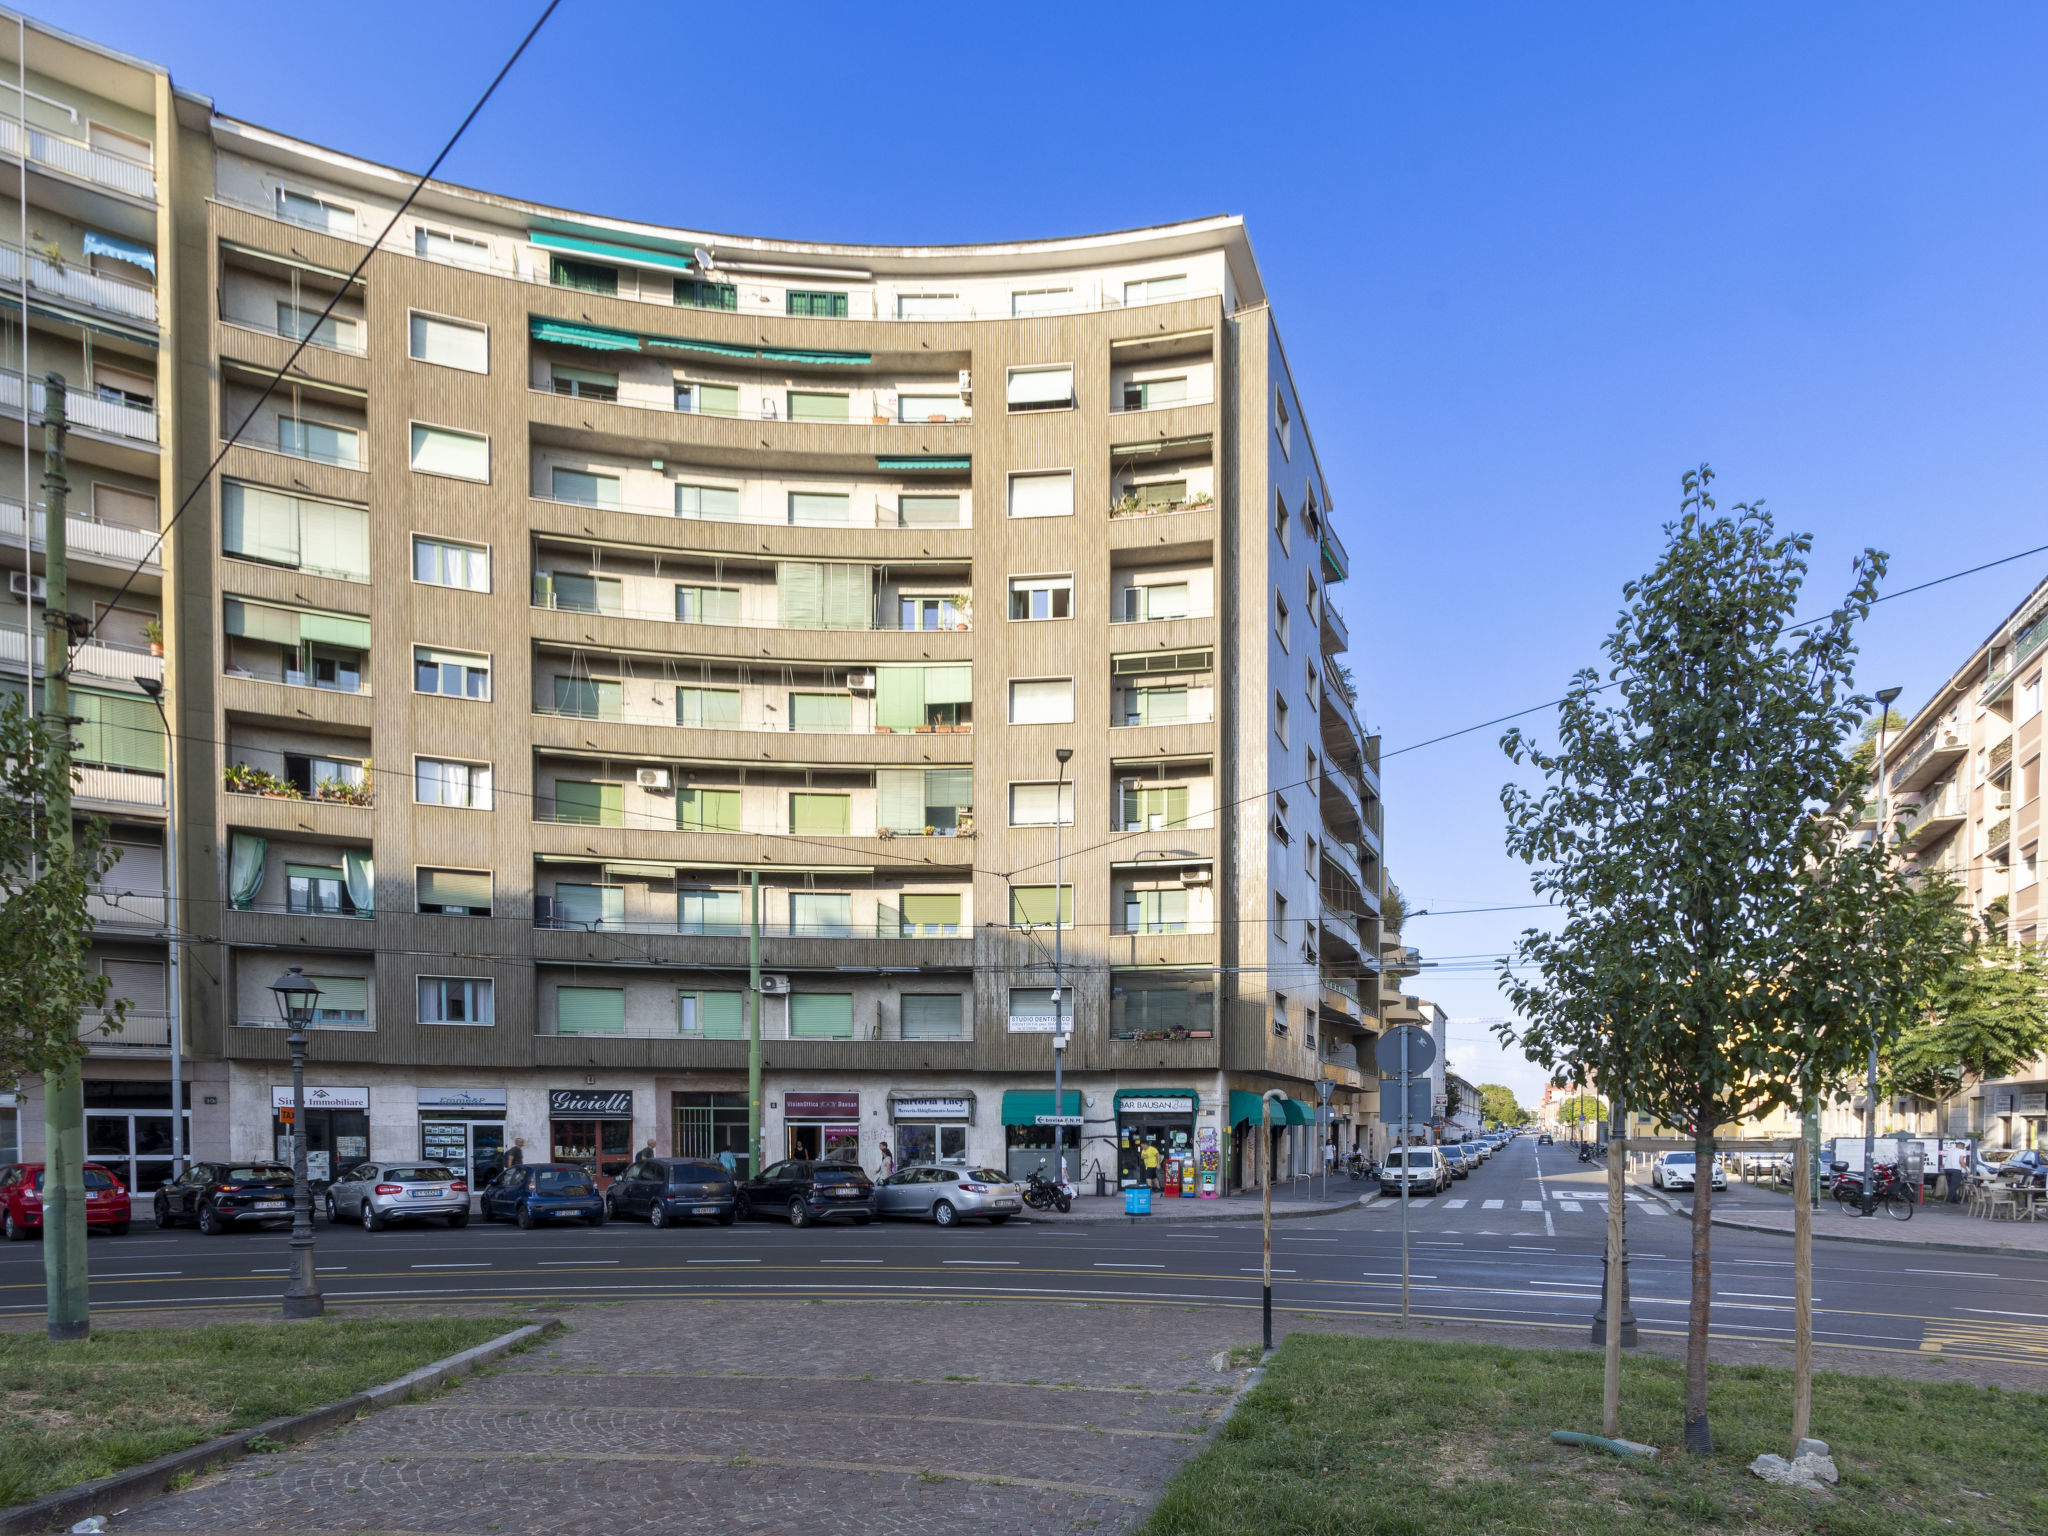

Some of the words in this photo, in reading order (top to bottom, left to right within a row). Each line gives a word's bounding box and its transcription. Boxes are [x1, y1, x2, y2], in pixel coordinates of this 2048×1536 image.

[309, 1098, 363, 1106] Immobiliare
[552, 1091, 631, 1110] Gioielli
[1119, 1101, 1135, 1109] BAR
[1137, 1101, 1171, 1109] BAUSAN
[282, 1111, 295, 1120] TAX
